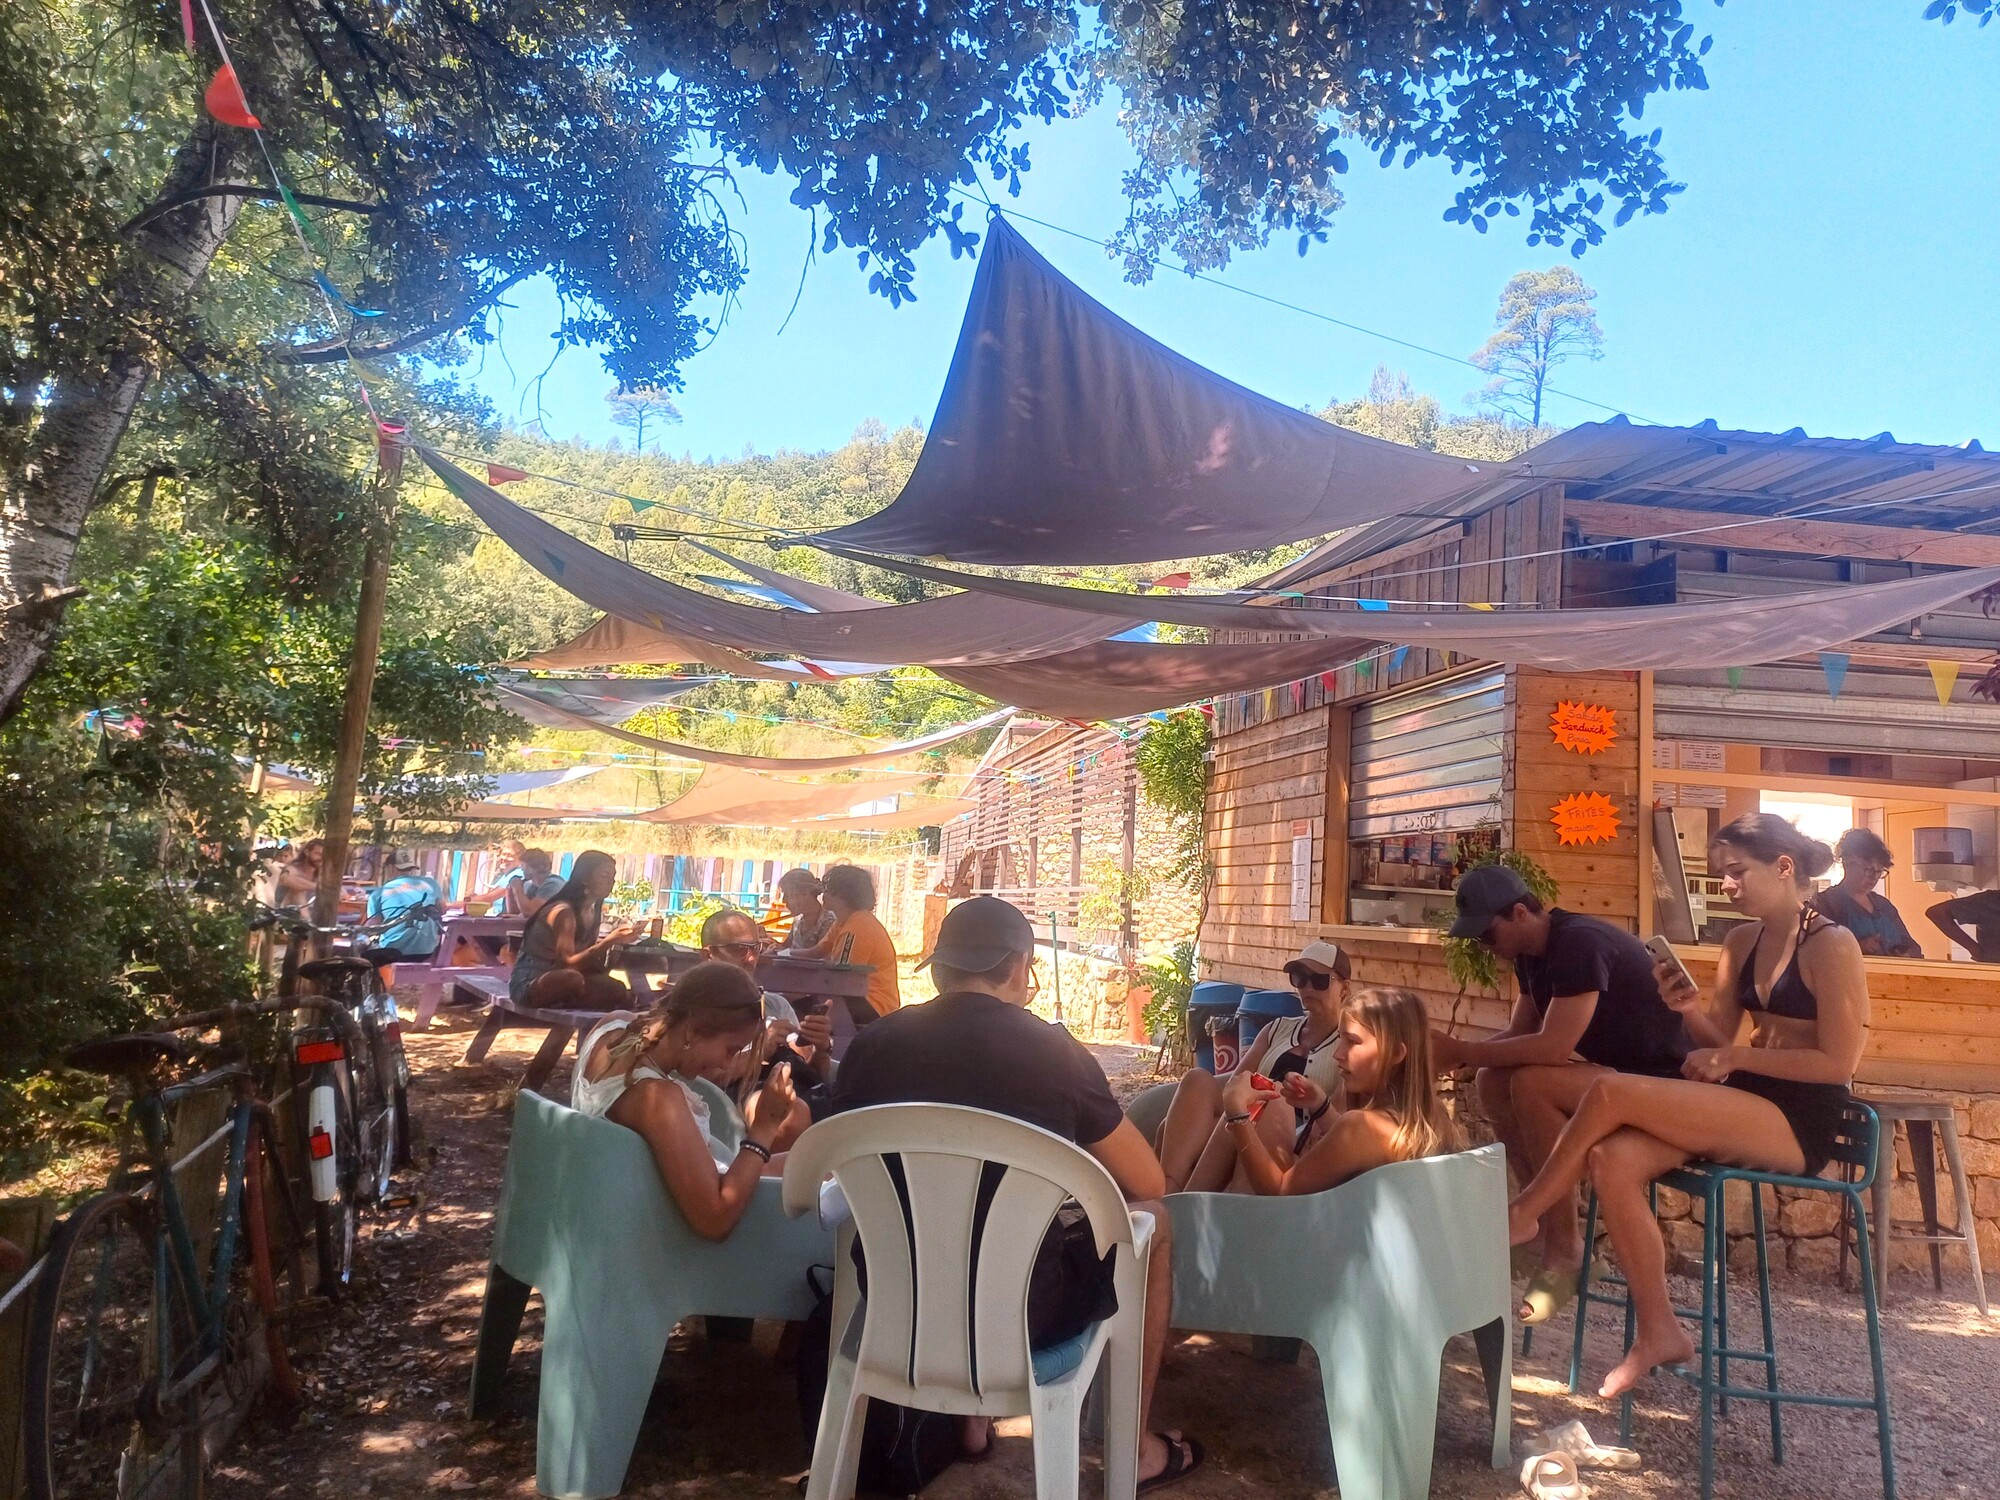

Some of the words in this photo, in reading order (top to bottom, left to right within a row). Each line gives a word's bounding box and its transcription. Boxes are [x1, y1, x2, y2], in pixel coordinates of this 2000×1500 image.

[1561, 719, 1607, 735] Sandwich
[1565, 806, 1605, 819] FRITES
[1564, 824, 1599, 833] maison
